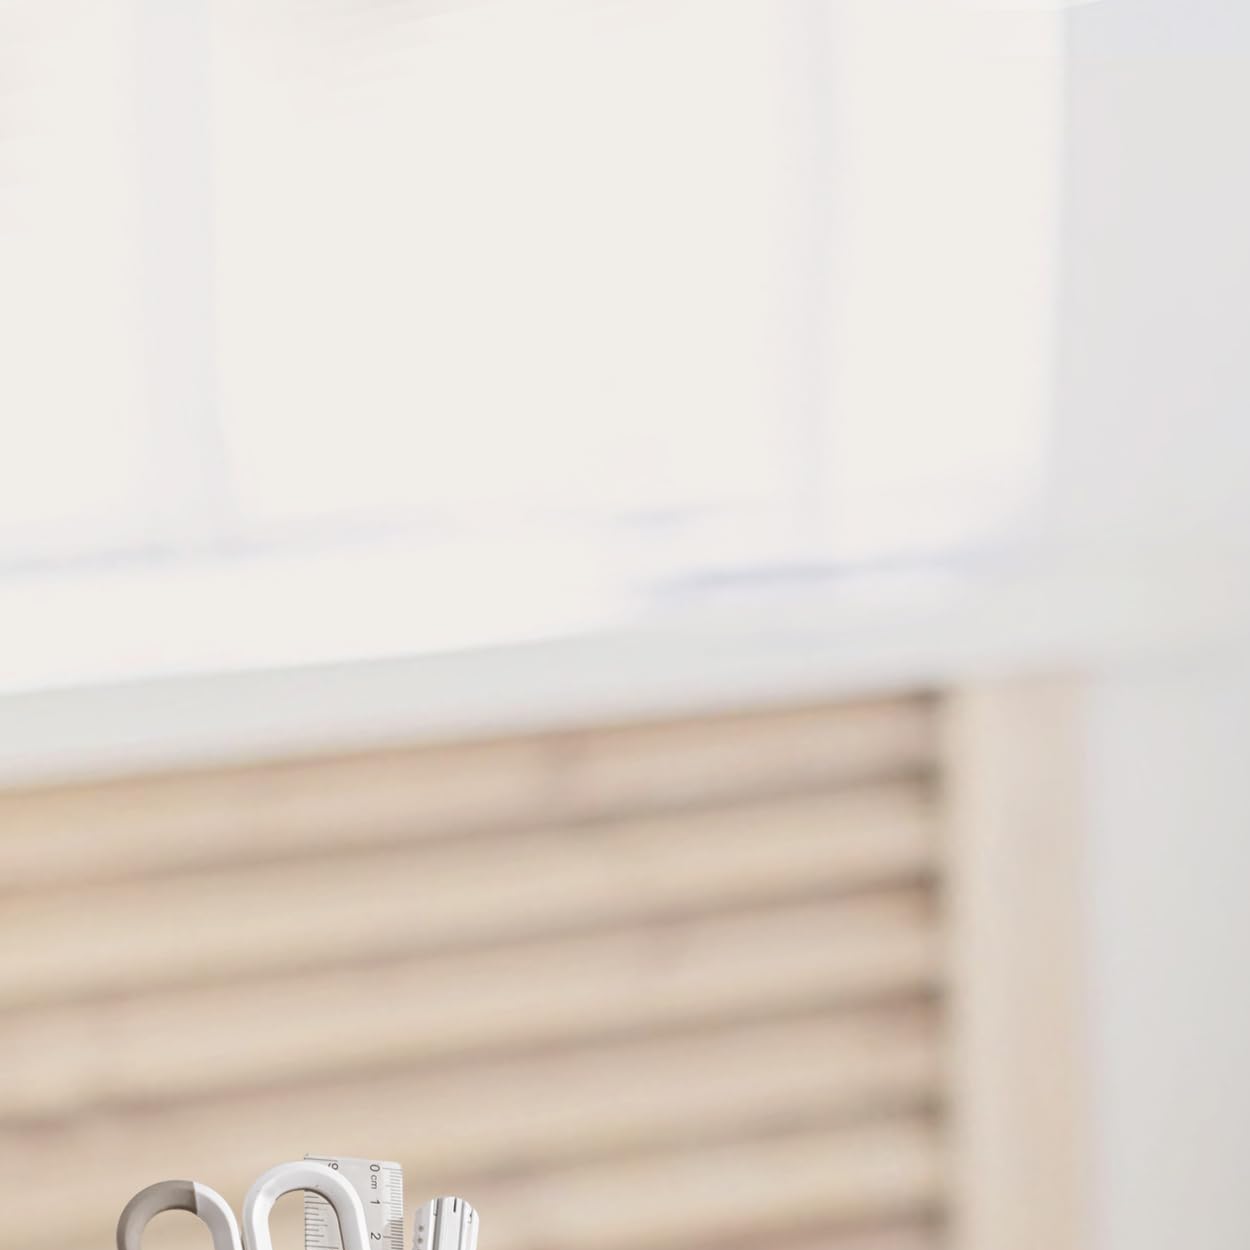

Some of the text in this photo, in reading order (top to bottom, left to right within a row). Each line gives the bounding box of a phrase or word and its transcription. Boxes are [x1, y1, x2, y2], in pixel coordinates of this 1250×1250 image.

[369, 1164, 381, 1173] 0
[370, 1174, 378, 1190] cm
[370, 1231, 382, 1241] 2
